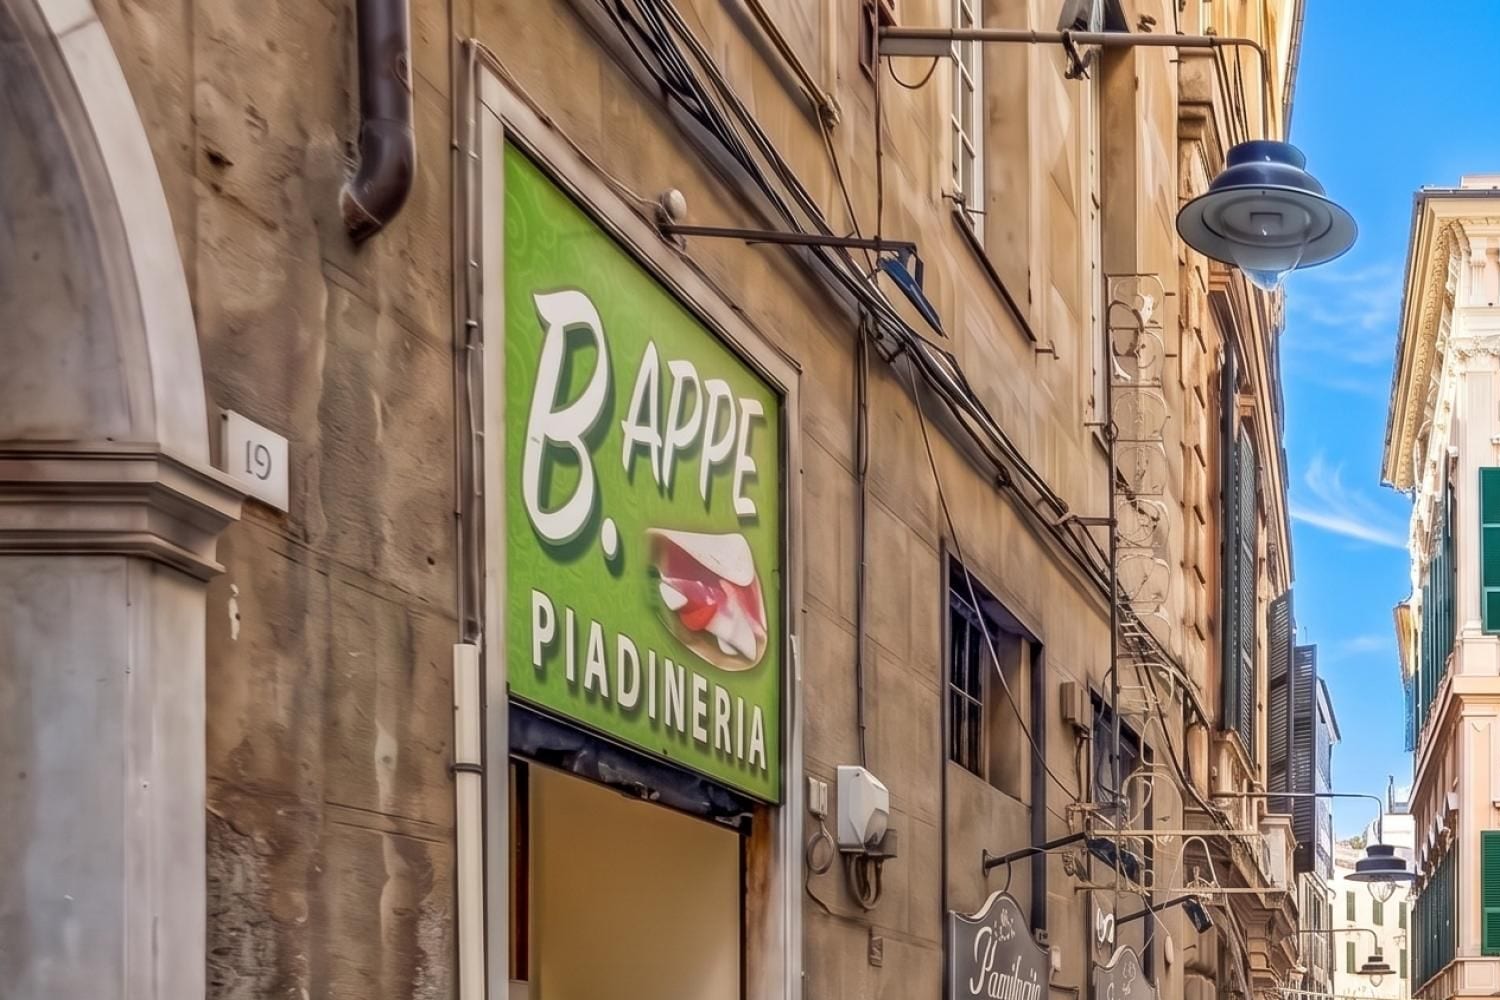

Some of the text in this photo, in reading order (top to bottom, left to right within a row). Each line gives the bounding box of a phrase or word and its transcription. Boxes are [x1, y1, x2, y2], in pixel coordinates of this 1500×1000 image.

[246, 440, 272, 481] 19
[621, 339, 765, 518] APPE
[531, 588, 767, 771] PIADINERIA
